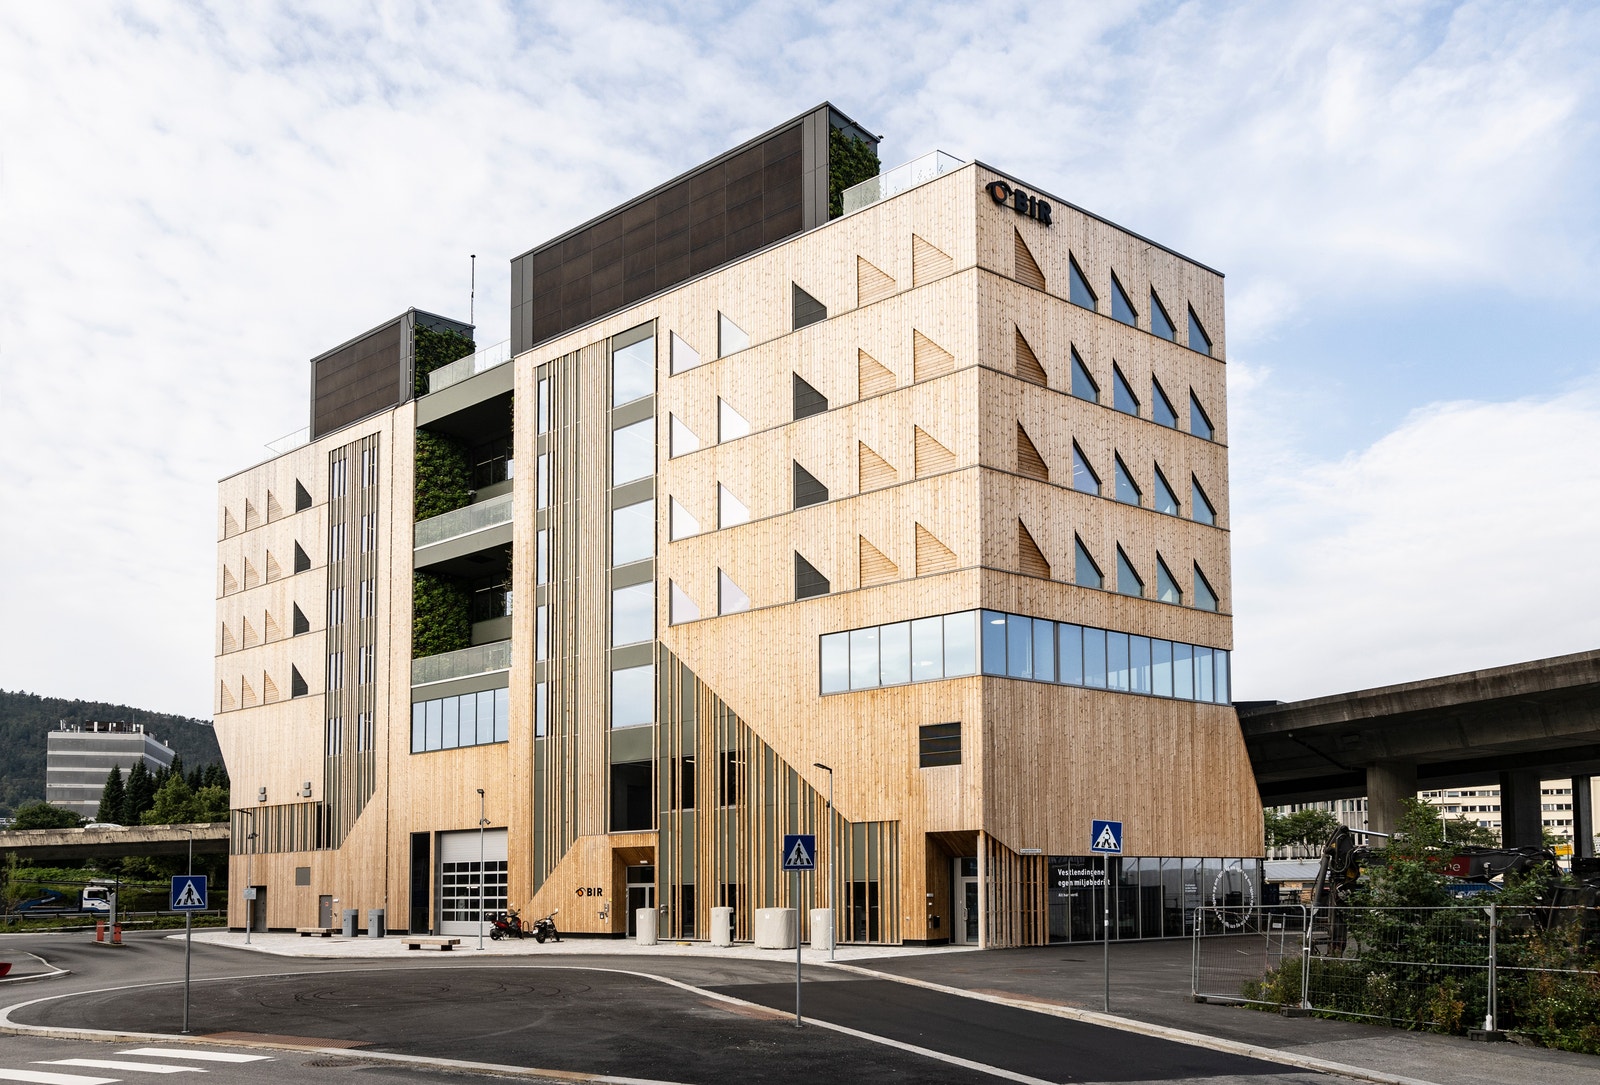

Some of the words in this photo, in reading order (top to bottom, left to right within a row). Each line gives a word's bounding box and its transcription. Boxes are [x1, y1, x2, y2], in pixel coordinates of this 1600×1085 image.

[1015, 189, 1052, 227] BIR
[1057, 868, 1107, 877] Vestlendingene
[1074, 879, 1110, 887] miljøbedrit
[587, 888, 602, 896] BIR
